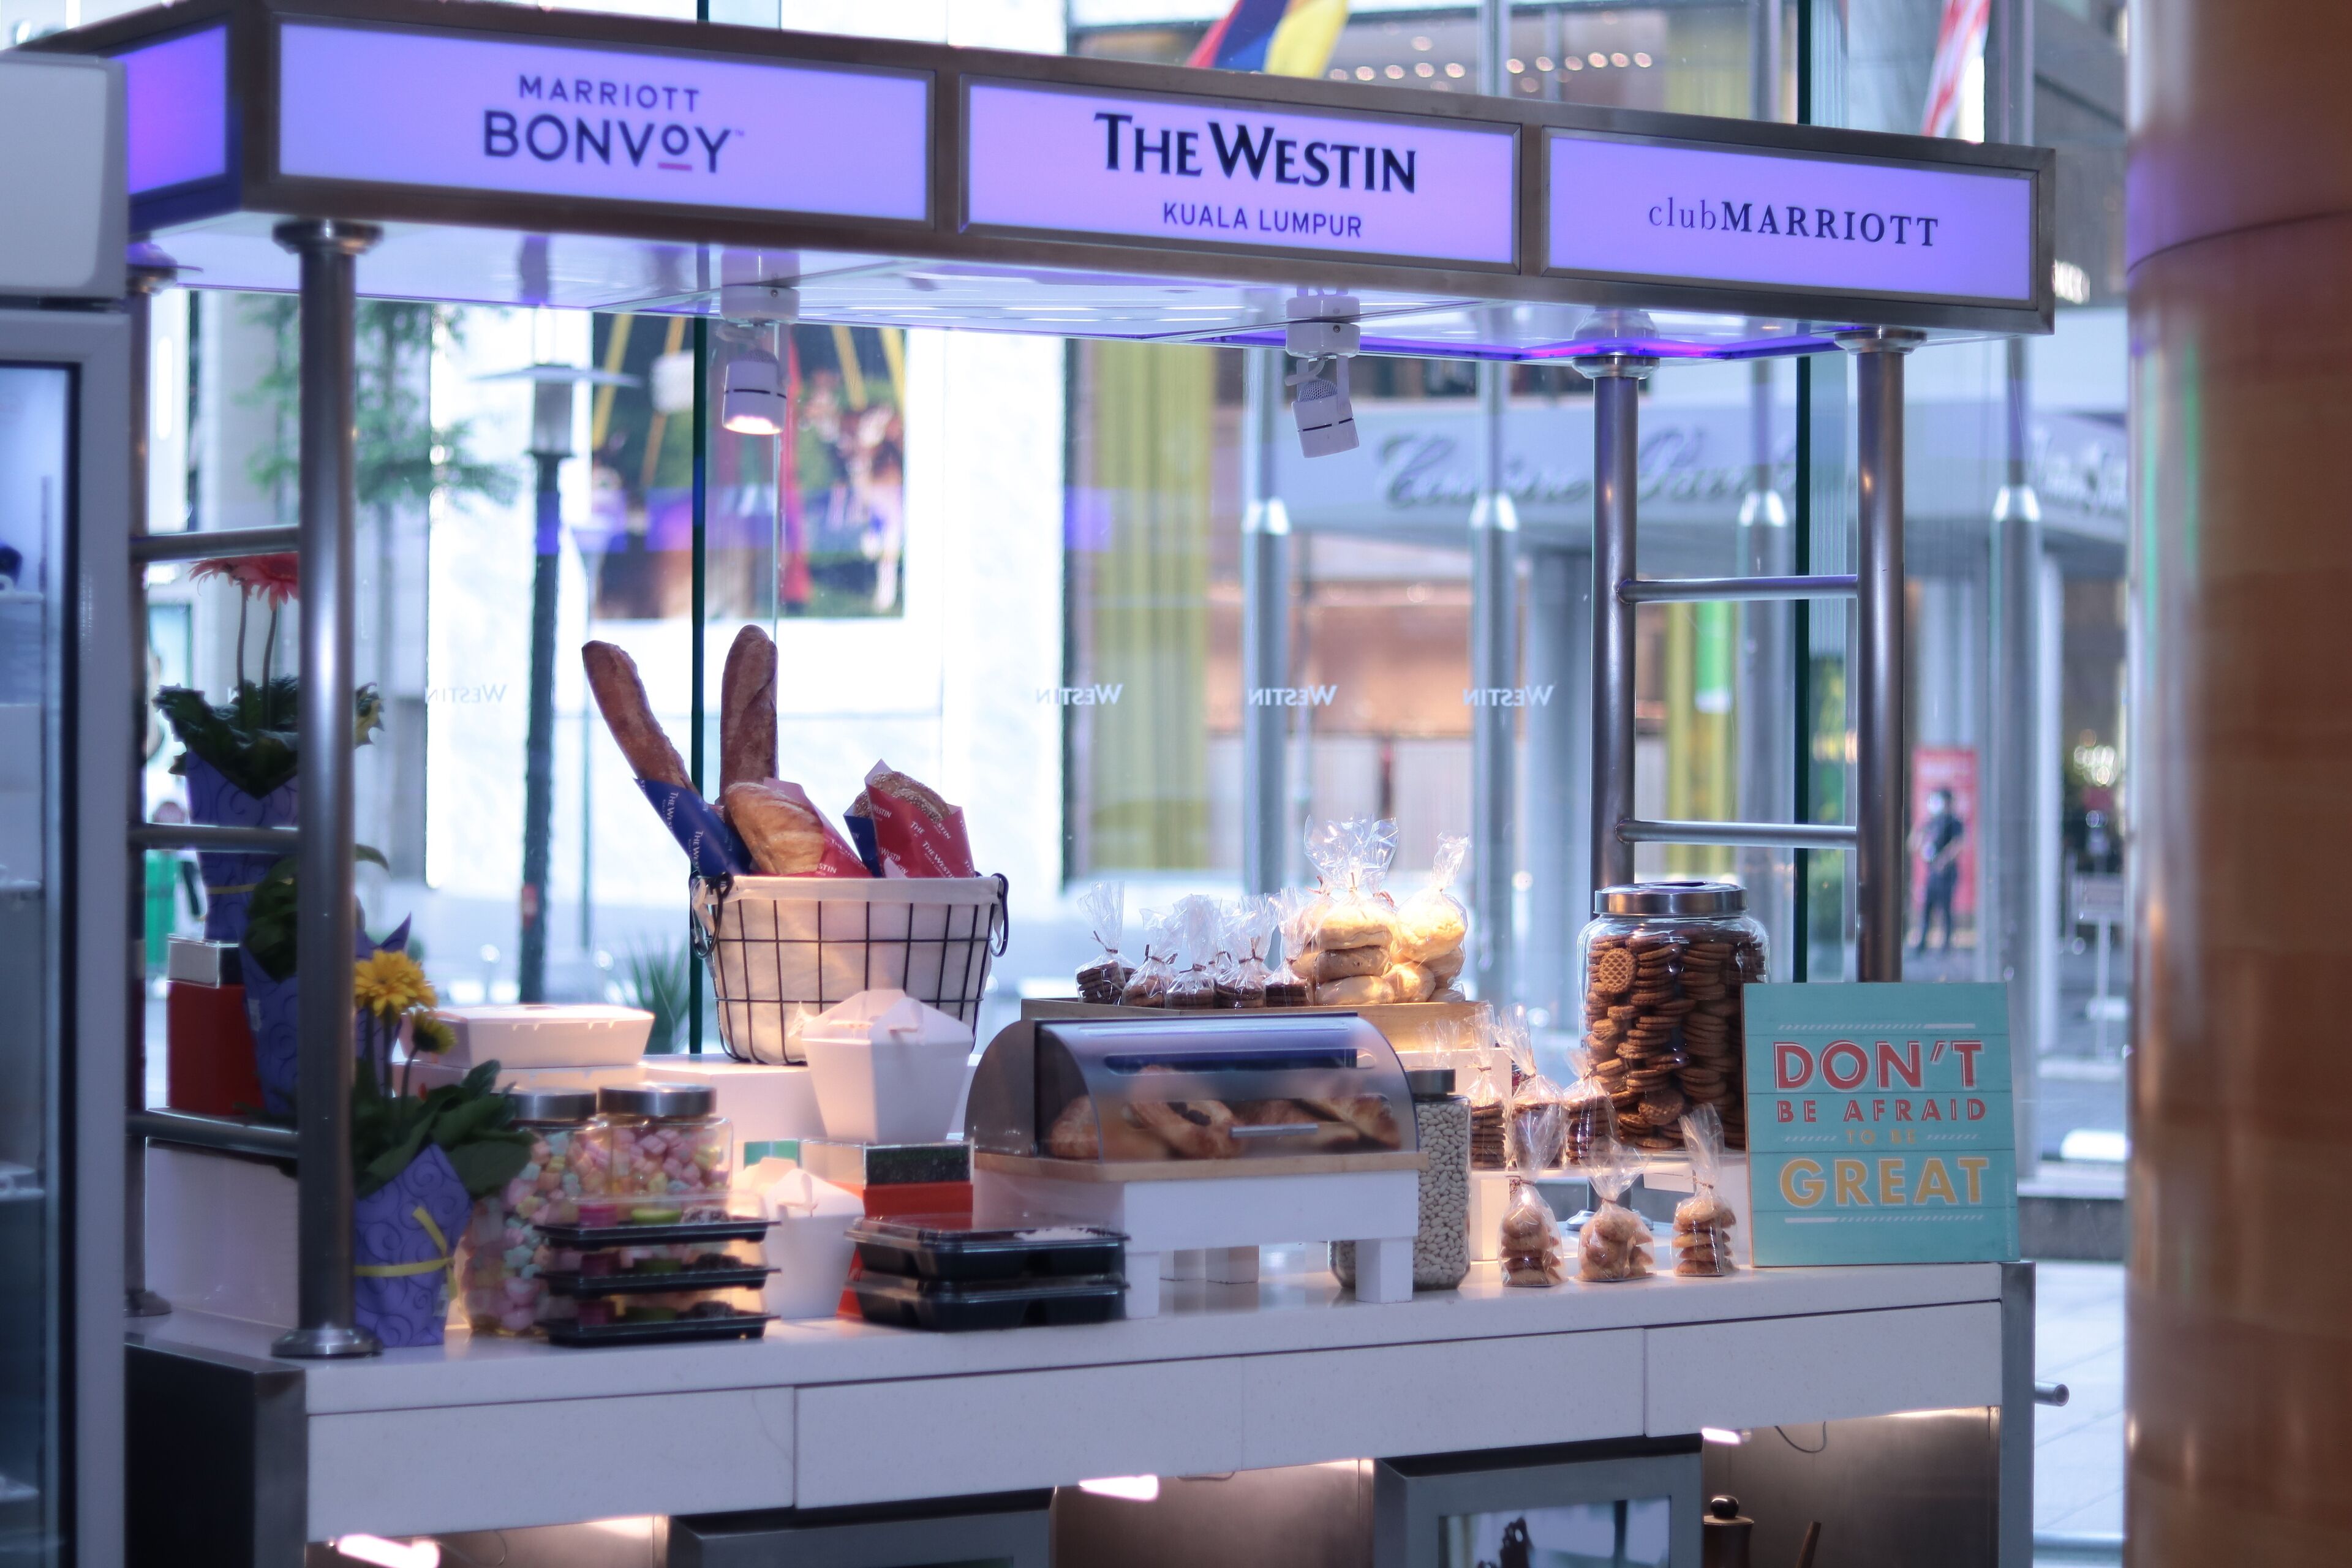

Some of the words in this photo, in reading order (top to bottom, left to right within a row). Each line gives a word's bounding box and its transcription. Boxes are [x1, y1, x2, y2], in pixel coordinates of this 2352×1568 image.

[519, 75, 699, 112] MARRIOTT
[1094, 112, 1202, 177] THE
[1207, 121, 1416, 194] WESTIN
[1163, 202, 1248, 230] KUALA
[1259, 209, 1362, 238] LUMPUR
[1649, 197, 1939, 246] clubMARRIOTT
[1773, 1039, 1985, 1093] DON'T
[1777, 1099, 1817, 1123] BE
[1843, 1098, 1986, 1122] AFRAID
[1845, 1129, 1875, 1145] TO
[1889, 1129, 1917, 1145] BE
[1779, 1156, 1989, 1208] GREAT
